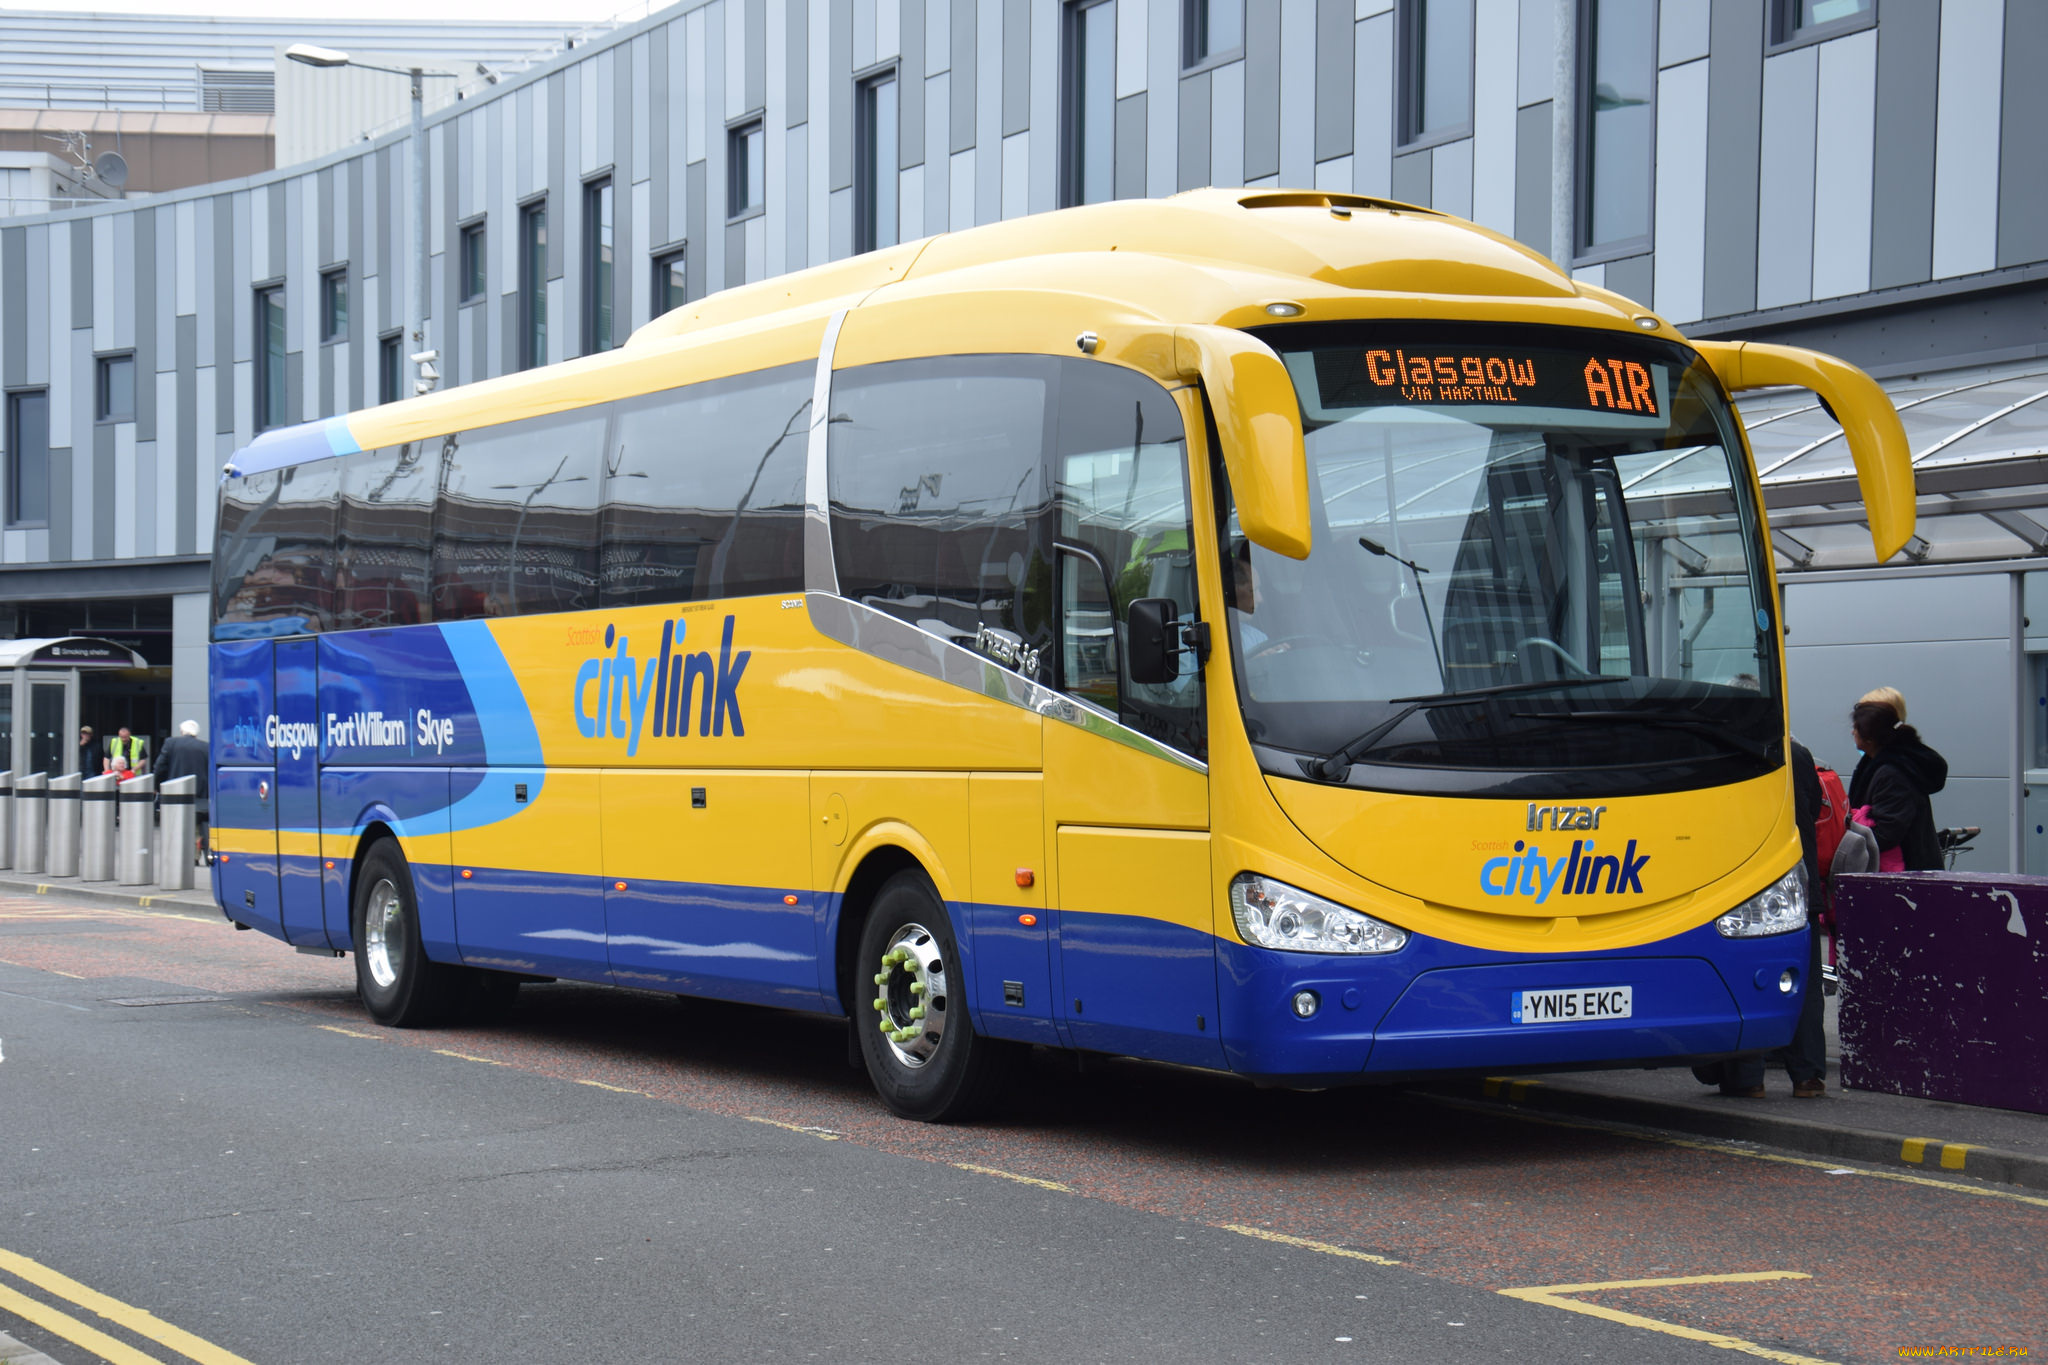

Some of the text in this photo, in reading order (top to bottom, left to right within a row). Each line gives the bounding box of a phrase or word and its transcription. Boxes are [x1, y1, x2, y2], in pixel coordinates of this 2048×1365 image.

[1365, 348, 1536, 387] Glasgow
[1402, 386, 1518, 401] VIA HARTHILL
[1583, 356, 1656, 414] AIR
[781, 598, 804, 610] SCANIA
[566, 624, 601, 647] Scottish
[574, 614, 752, 757] citylink
[265, 714, 319, 760] Glasgow
[327, 713, 355, 747] Fort
[354, 711, 406, 747] William
[417, 708, 454, 755] Skye
[1526, 802, 1607, 832] Irizar
[1471, 839, 1510, 851] Scottish
[1480, 839, 1651, 904] citylink
[1530, 991, 1623, 1019] YN15 EKC
